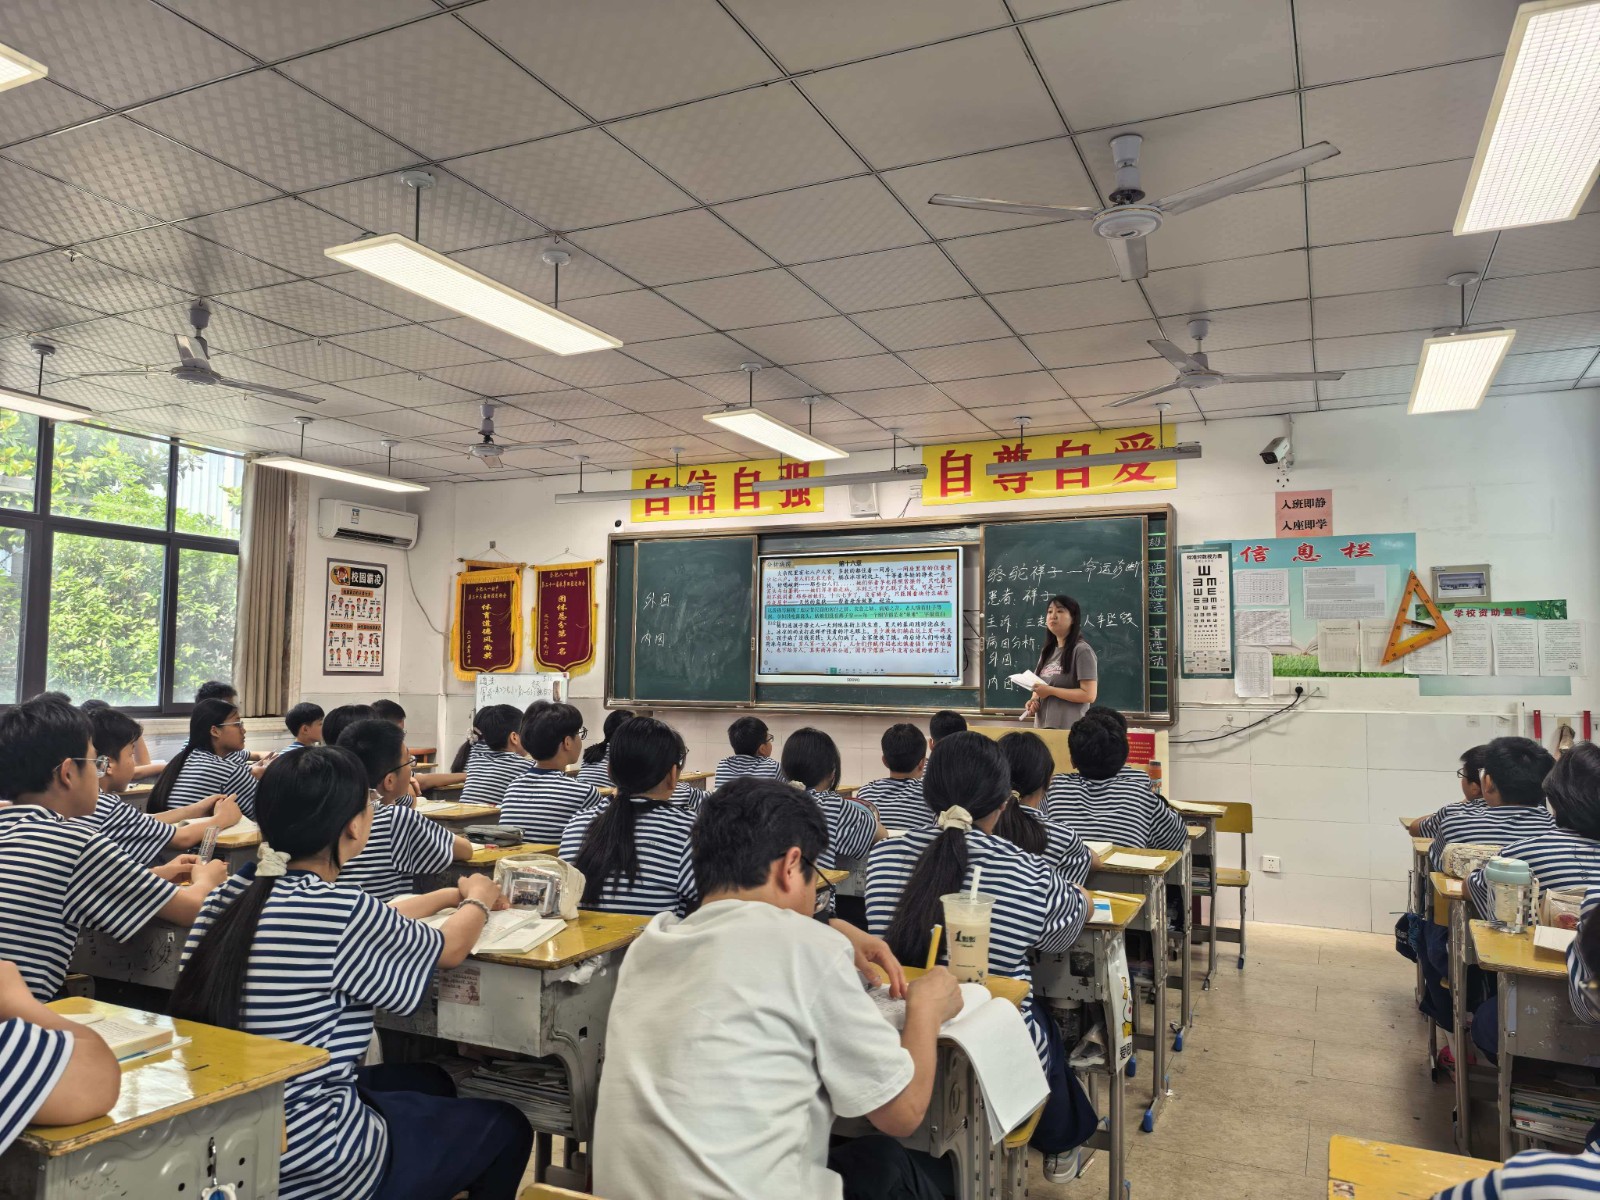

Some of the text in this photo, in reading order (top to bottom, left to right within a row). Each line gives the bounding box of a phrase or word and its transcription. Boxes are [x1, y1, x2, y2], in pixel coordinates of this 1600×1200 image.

[940, 432, 1157, 498] 自尊自爱
[645, 463, 811, 516] 自信自强
[1281, 497, 1327, 510] 入班即静
[1281, 518, 1328, 531] 入座即学
[1240, 541, 1375, 564] 信息栏
